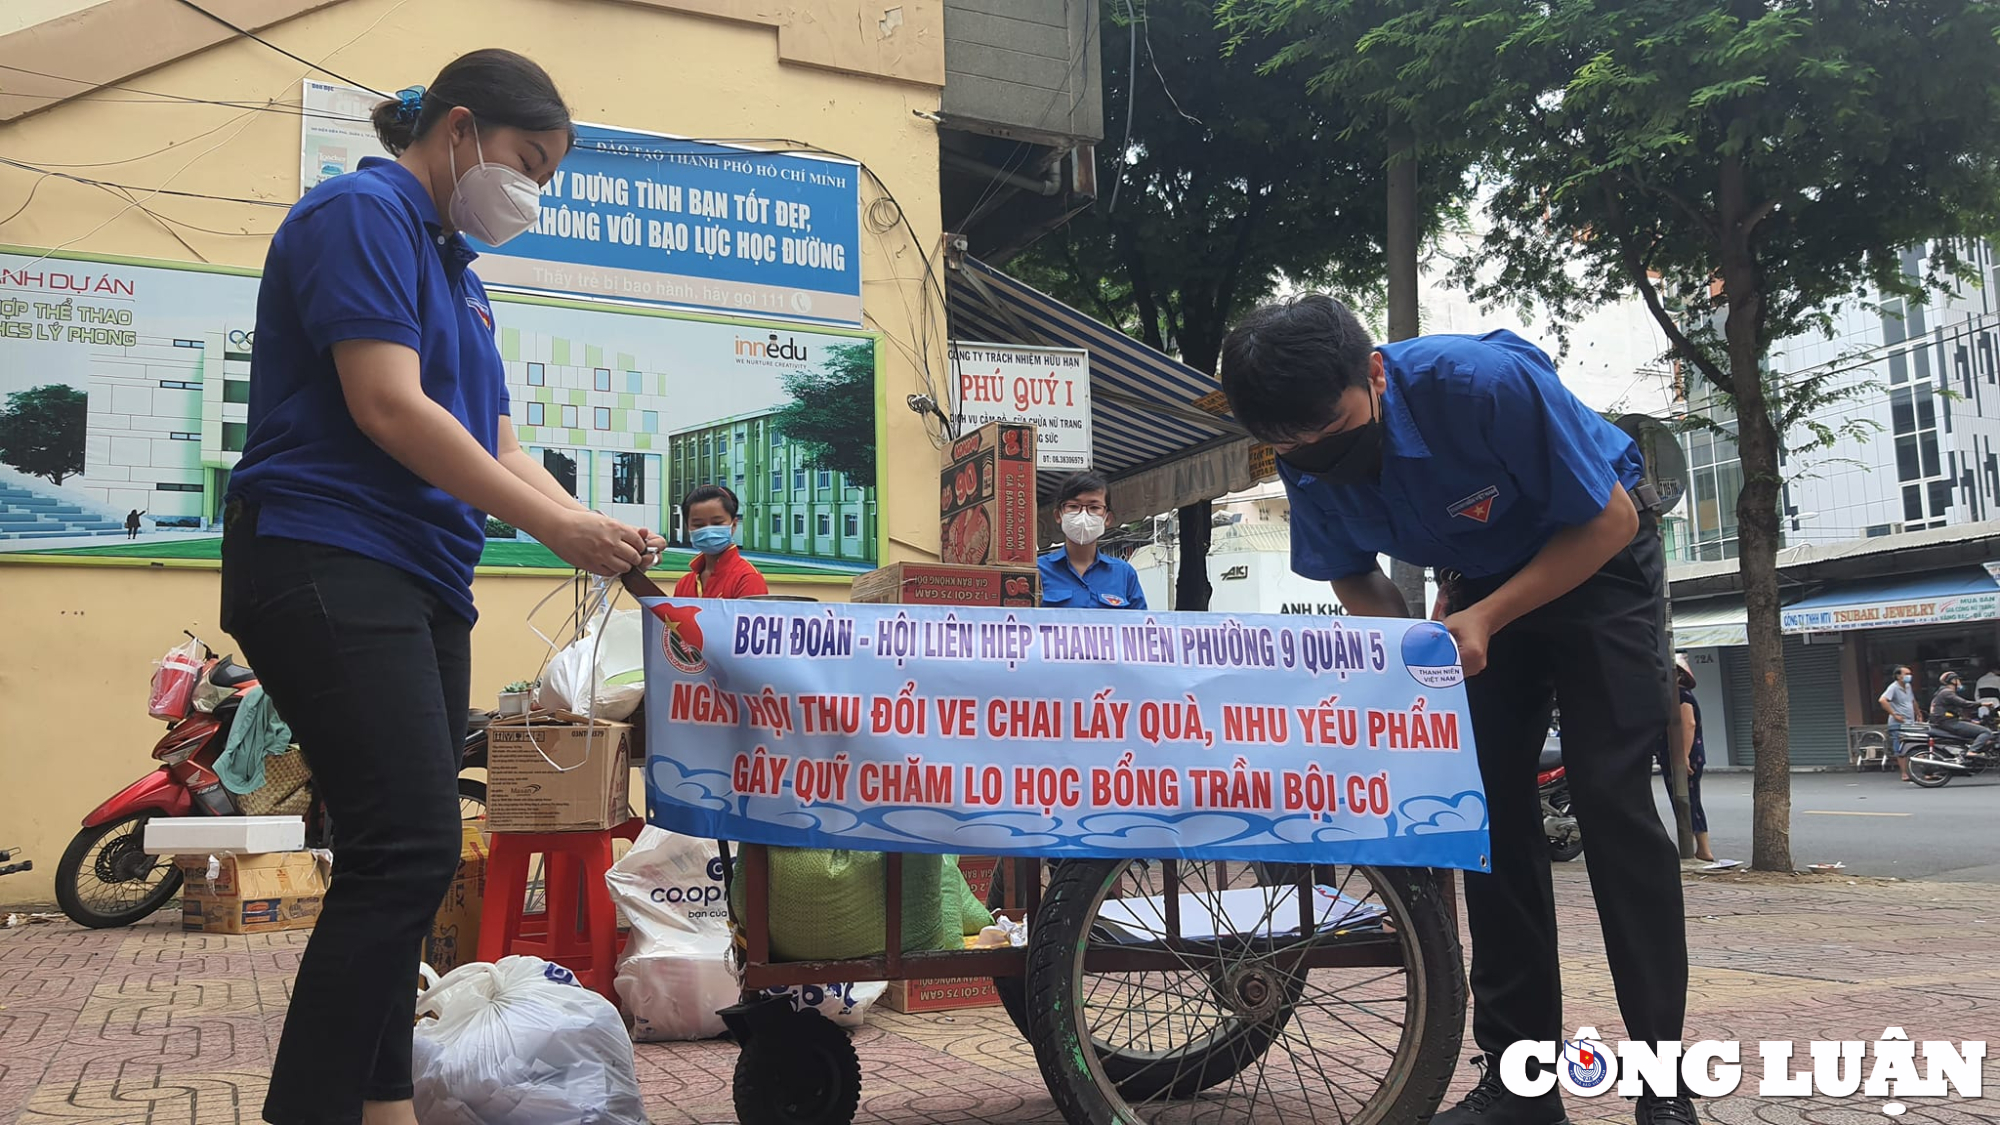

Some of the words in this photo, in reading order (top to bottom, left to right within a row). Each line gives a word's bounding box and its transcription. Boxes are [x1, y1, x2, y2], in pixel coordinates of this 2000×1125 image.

[668, 147, 719, 169] THÀNH
[724, 159, 753, 175] PHỐ
[756, 161, 778, 178] HỒ
[781, 165, 805, 182] CHÍ
[809, 173, 846, 189] MINH
[572, 171, 628, 207] DỰNG
[635, 178, 681, 212] TÌNH
[689, 188, 727, 222] BẠN
[734, 188, 770, 224] TỐT
[775, 199, 811, 233] ĐẸP,
[606, 211, 641, 246] VỚI
[648, 219, 688, 255] BẠO
[695, 224, 730, 259] LỰC
[737, 230, 775, 265] HỌC
[782, 234, 845, 271] ĐƯỜNG
[0, 269, 43, 288] NH
[49, 273, 91, 294] DỰ
[94, 273, 134, 296] ÁN
[532, 265, 572, 288] Thấy
[578, 270, 599, 288] trẻ
[603, 274, 619, 291] bị
[624, 276, 651, 294] bạo
[656, 280, 697, 299] hành,
[703, 285, 729, 304] hãy
[734, 290, 756, 307] gọi
[763, 292, 783, 308] 111
[0, 297, 28, 320] ỢP
[33, 298, 72, 321] THỂ
[77, 306, 133, 326] THAO
[37, 321, 63, 341] LÝ
[67, 326, 137, 347] PHONG
[973, 351, 983, 362] TY
[985, 351, 1013, 364] TRÁCH
[1015, 353, 1041, 367] NHIỆM
[1044, 353, 1061, 367] HỮU
[1063, 357, 1080, 369] HẠN
[960, 367, 1004, 403] PHÚ
[1013, 371, 1059, 412] QUÝ
[1060, 419, 1082, 429] TRANG
[1045, 431, 1059, 444] SỨC
[1006, 510, 1014, 535] KHÔNG
[1016, 527, 1026, 550] GAM
[930, 576, 956, 587] KHÔNG
[914, 588, 940, 599] GAM
[1280, 603, 1312, 615] ANH
[1833, 607, 1880, 623] TSUBAKI
[1883, 602, 1936, 619] JEWELRY
[734, 615, 783, 655] BCH
[789, 610, 852, 656] ĐOÀN
[878, 612, 916, 666] HỘI
[925, 613, 973, 659] LIÊN
[981, 615, 1032, 668] HIỆP
[1039, 625, 1115, 660] THANH
[1122, 618, 1174, 663] NIÊN
[1184, 619, 1275, 667] PHƯỜNG
[1281, 629, 1295, 665] 9
[1303, 621, 1364, 679] QUẬN
[1370, 632, 1385, 671] 5
[1695, 653, 1714, 664] 72A
[1443, 667, 1460, 675] NIÊN
[671, 680, 738, 724] NGÀY
[744, 687, 792, 737] HỘI
[799, 696, 860, 734] THU
[871, 681, 925, 734] ĐỔI
[937, 699, 975, 736] VE
[987, 699, 1060, 739] CHAI
[1074, 688, 1129, 739] LẤY
[1140, 690, 1213, 747] QUÀ,
[1224, 705, 1286, 742] NHU
[1297, 696, 1357, 746] YẾU
[1368, 697, 1459, 750] PHẨM
[733, 747, 788, 795] GÂY
[795, 754, 850, 803] QUỸ
[860, 756, 952, 804] CHĂM
[965, 766, 1002, 806] LO
[1015, 767, 1080, 815] HỌC
[1092, 751, 1178, 807] BỔNG
[1189, 757, 1271, 809] TRẦN
[1284, 764, 1336, 820] BỘI
[1347, 772, 1389, 815] CƠ
[688, 910, 707, 920] bạn
[710, 909, 727, 918] của
[920, 989, 945, 1001] GAM
[947, 988, 958, 998] 75
